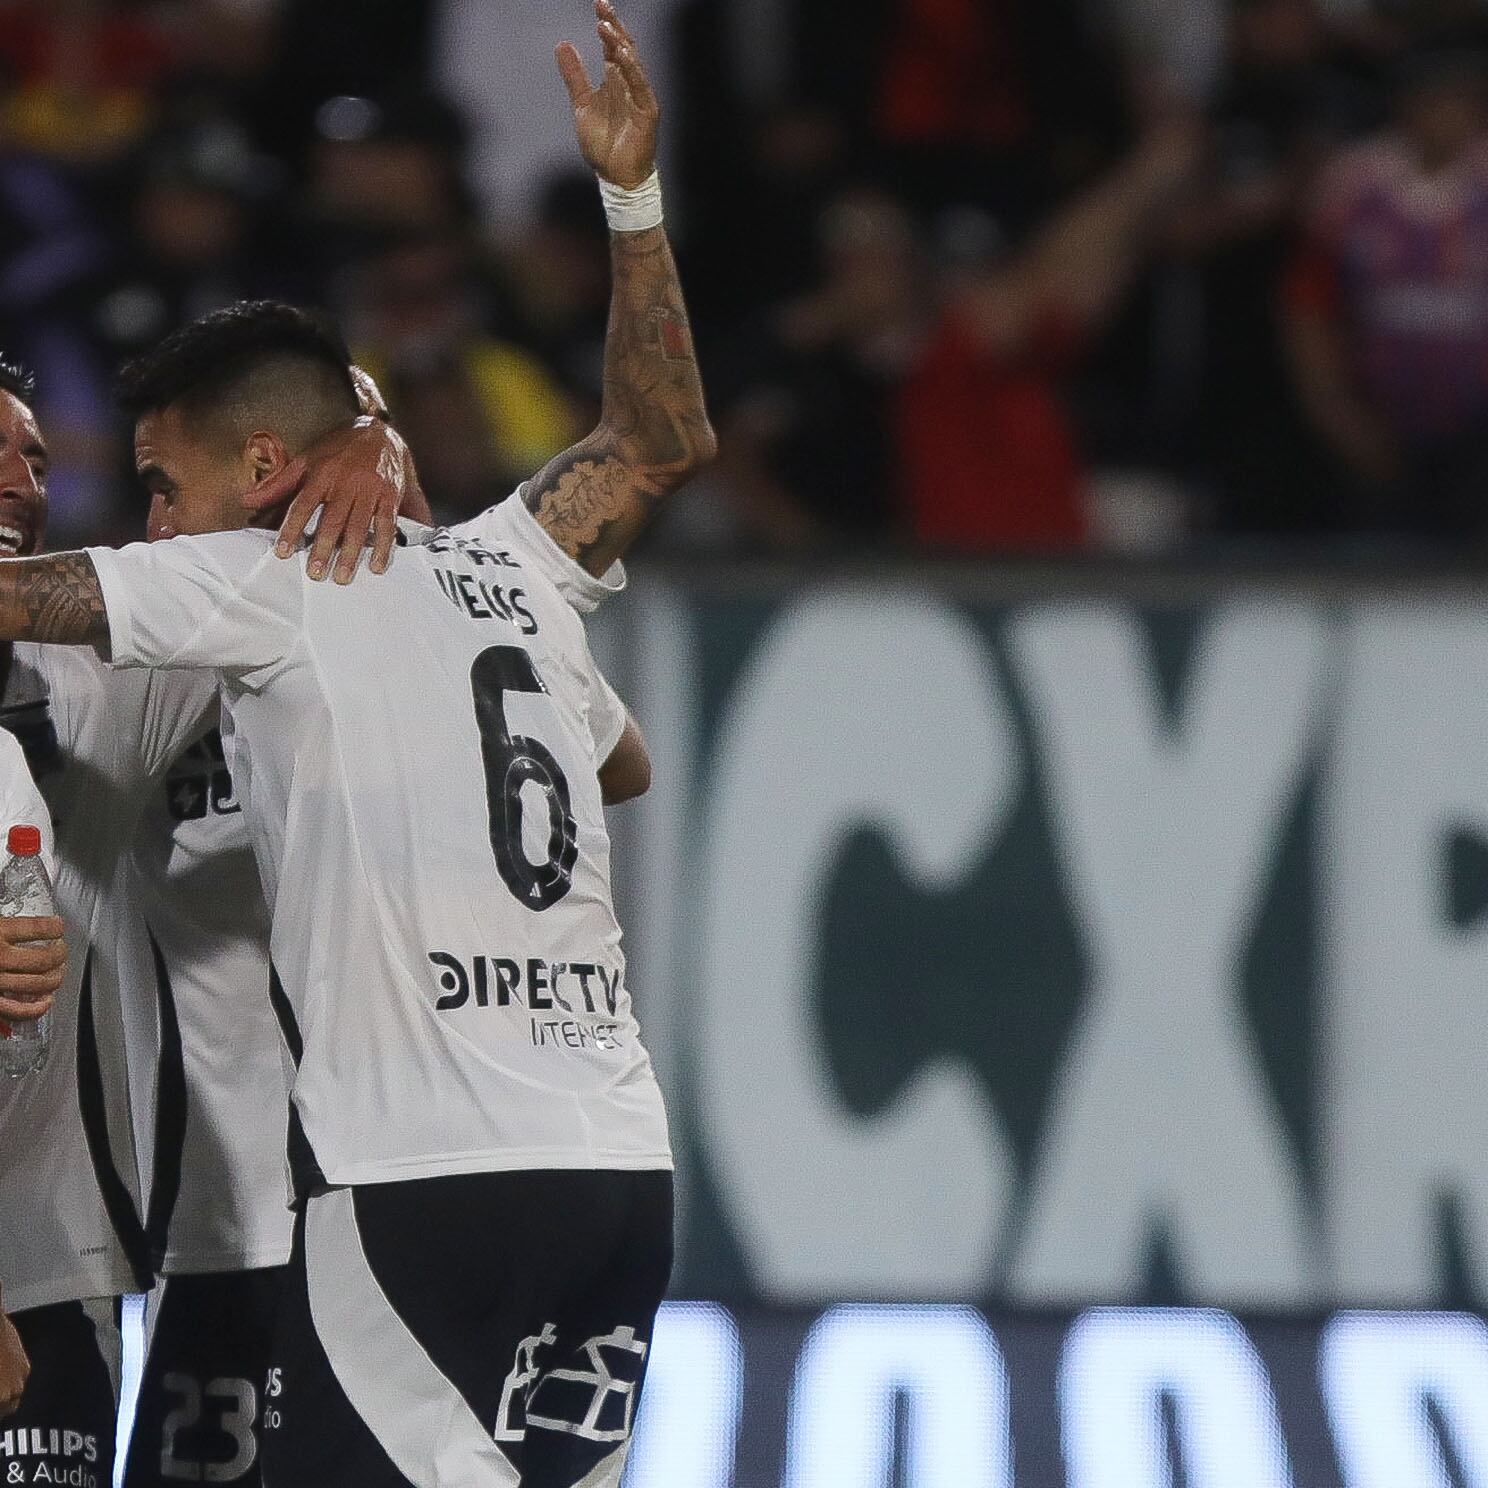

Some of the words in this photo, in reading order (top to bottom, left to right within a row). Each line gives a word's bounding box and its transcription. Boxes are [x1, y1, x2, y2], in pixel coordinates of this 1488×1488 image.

[470, 645, 578, 911] 6
[428, 951, 619, 1017] DIRECTV
[161, 1371, 257, 1482] 23
[6, 1461, 25, 1484] &
